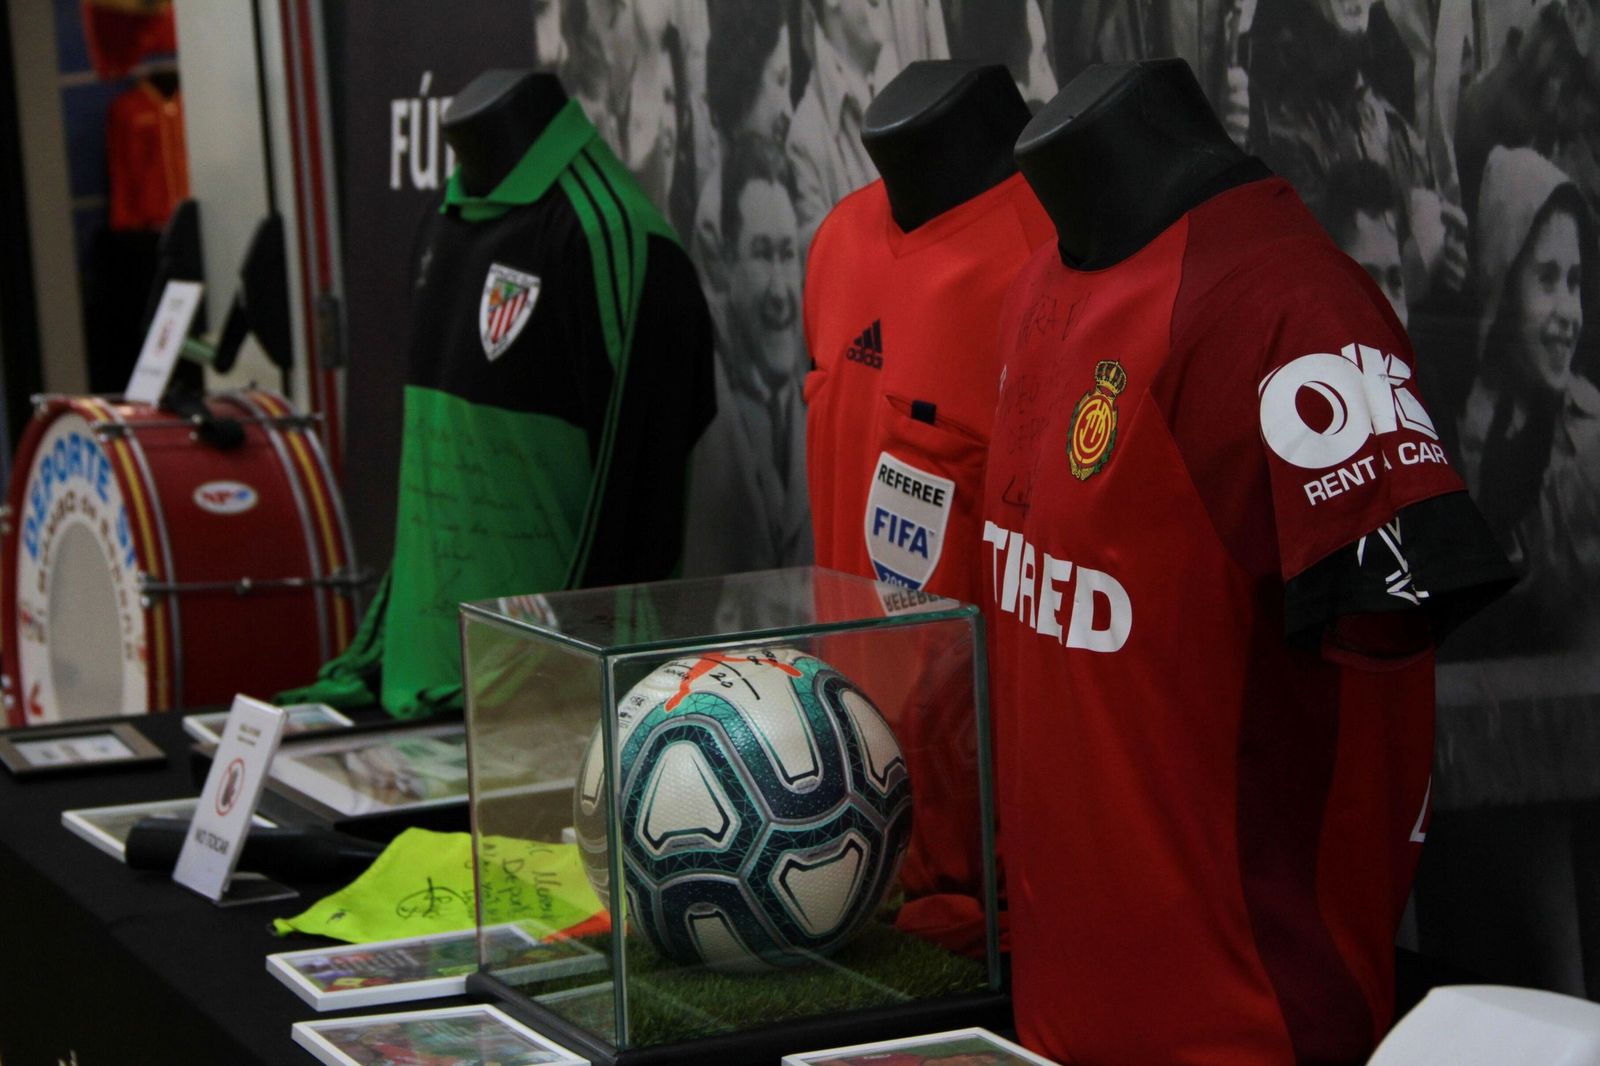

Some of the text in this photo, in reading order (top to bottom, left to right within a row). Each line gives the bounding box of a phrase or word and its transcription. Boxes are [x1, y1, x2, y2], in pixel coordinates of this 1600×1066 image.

[1258, 342, 1439, 469] OK
[877, 463, 945, 507] REFEREE
[1303, 456, 1377, 506] RENT
[1397, 442, 1449, 465] CAR
[873, 507, 929, 559] FIFA
